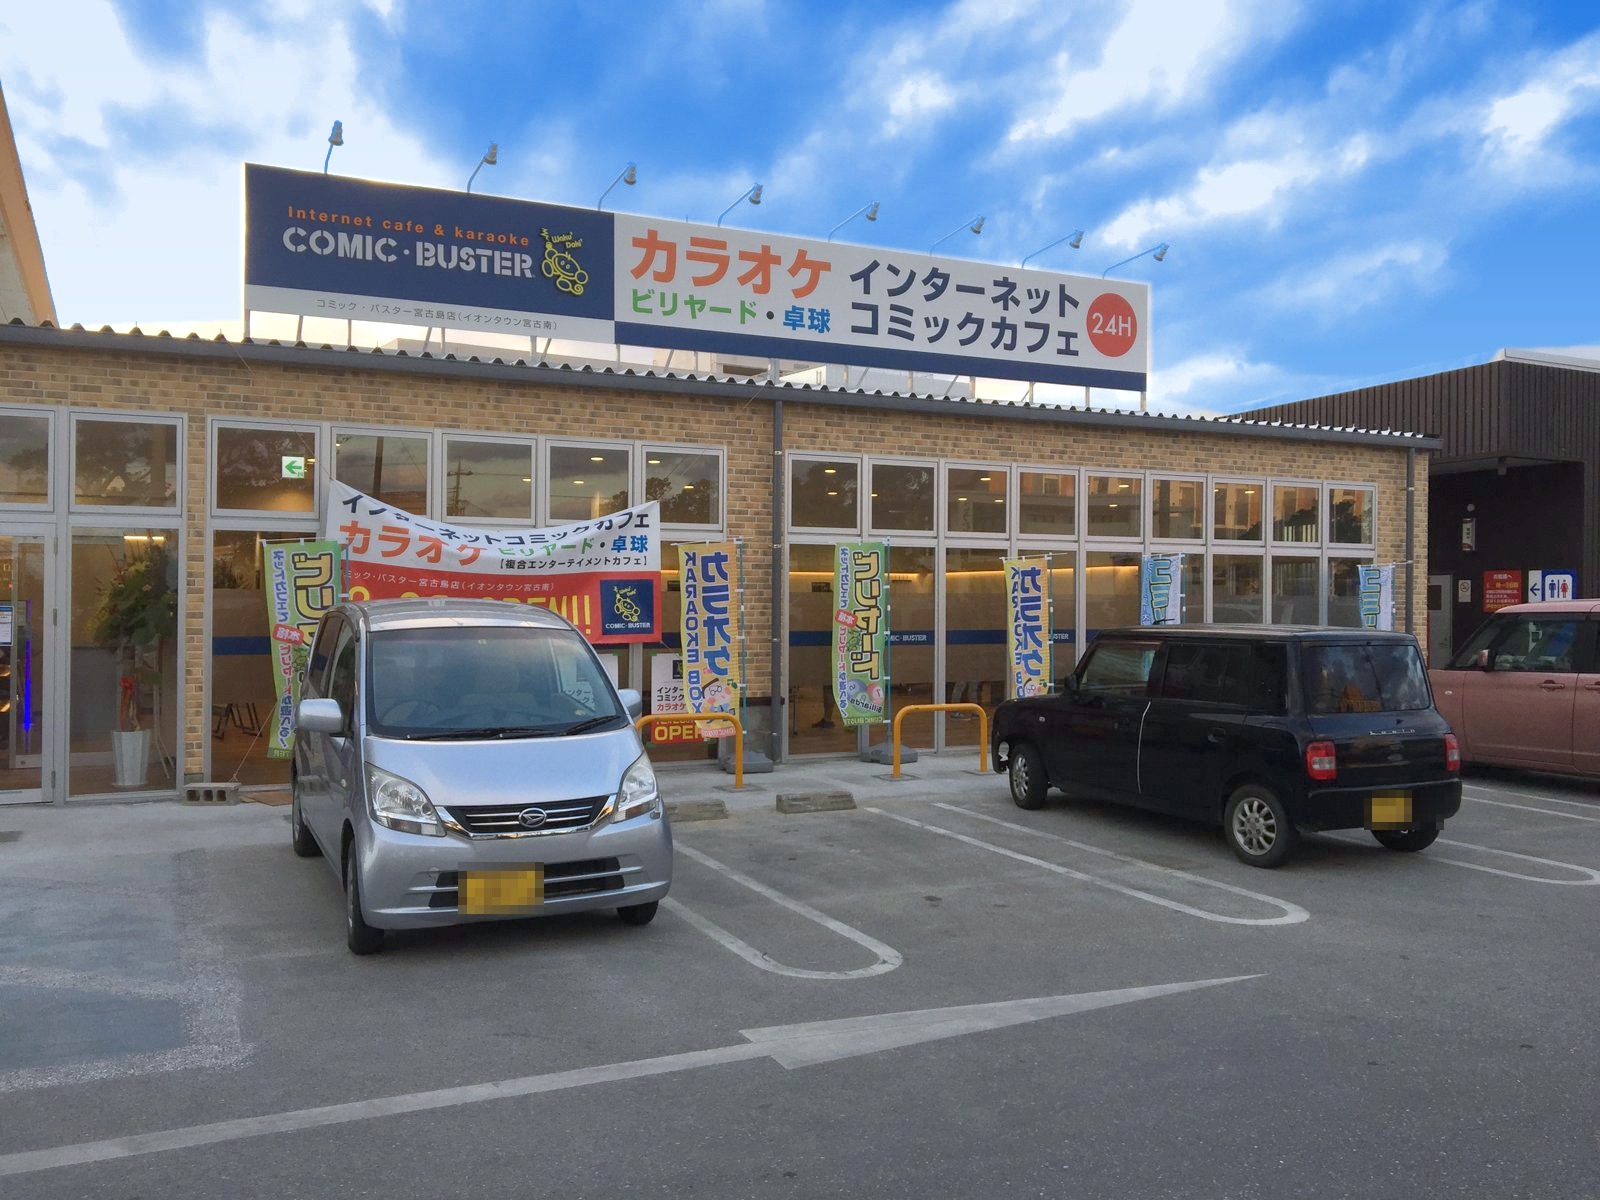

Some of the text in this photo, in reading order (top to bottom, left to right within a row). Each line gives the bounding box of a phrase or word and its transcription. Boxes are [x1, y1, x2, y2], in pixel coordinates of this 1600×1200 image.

[287, 205, 530, 247] Internet cafe & karaoke
[630, 229, 832, 298] カラオケ
[850, 259, 1080, 318] インターネット
[632, 288, 832, 334] ビリヤード・卓球
[850, 301, 1080, 357] コミックカフェ
[1091, 311, 1133, 338] 24H
[339, 520, 489, 567] カラオケ
[498, 534, 649, 556] ビリヤード・卓球
[343, 569, 555, 592] ミック・バスター宮古島店(イオンタウン宮古南)
[657, 686, 684, 694] インター
